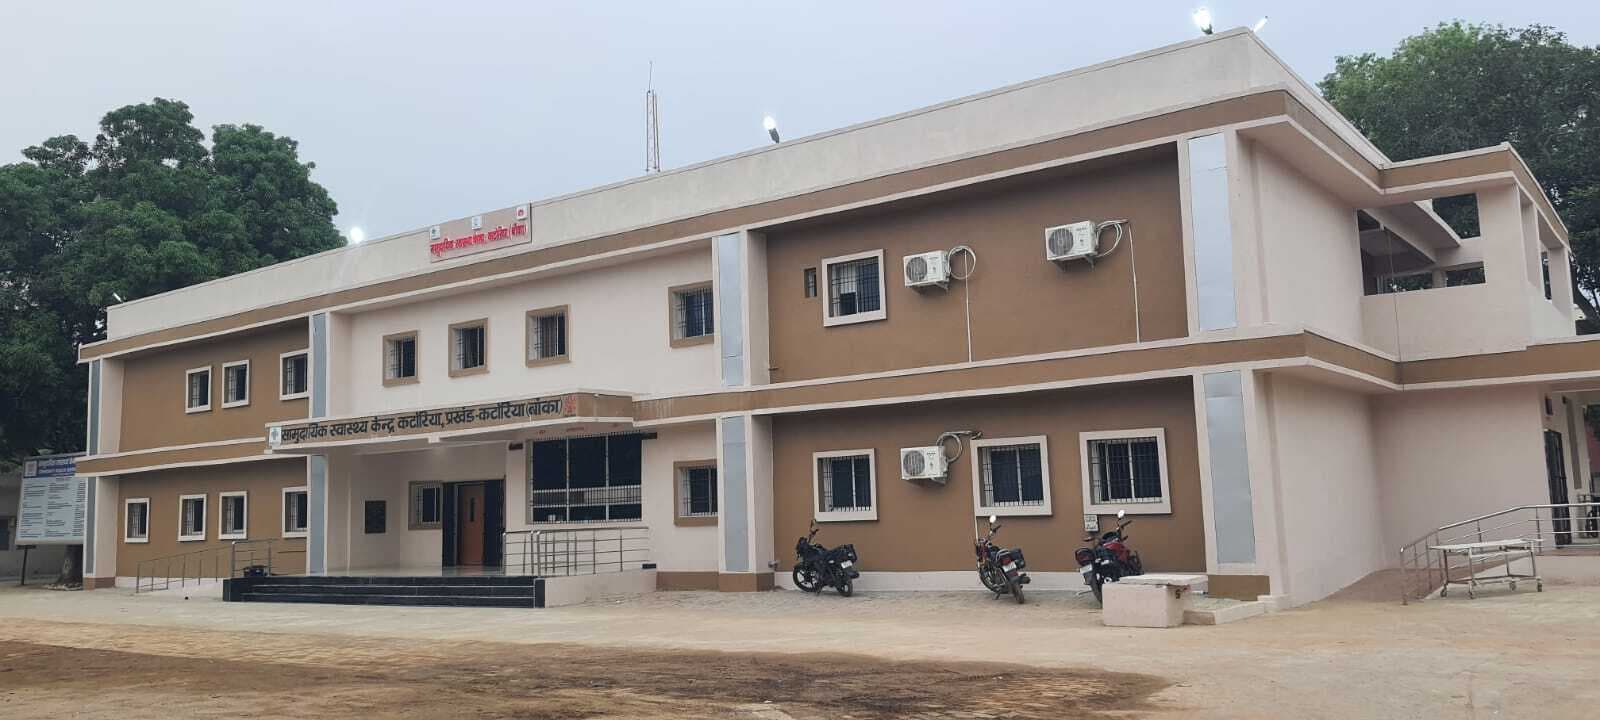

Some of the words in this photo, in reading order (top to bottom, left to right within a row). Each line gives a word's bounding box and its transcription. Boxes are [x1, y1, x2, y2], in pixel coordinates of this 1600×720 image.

[281, 422, 327, 443] सामुदायिक
[329, 420, 368, 436] स्वास्थ्य
[370, 415, 395, 433] केन्द्र
